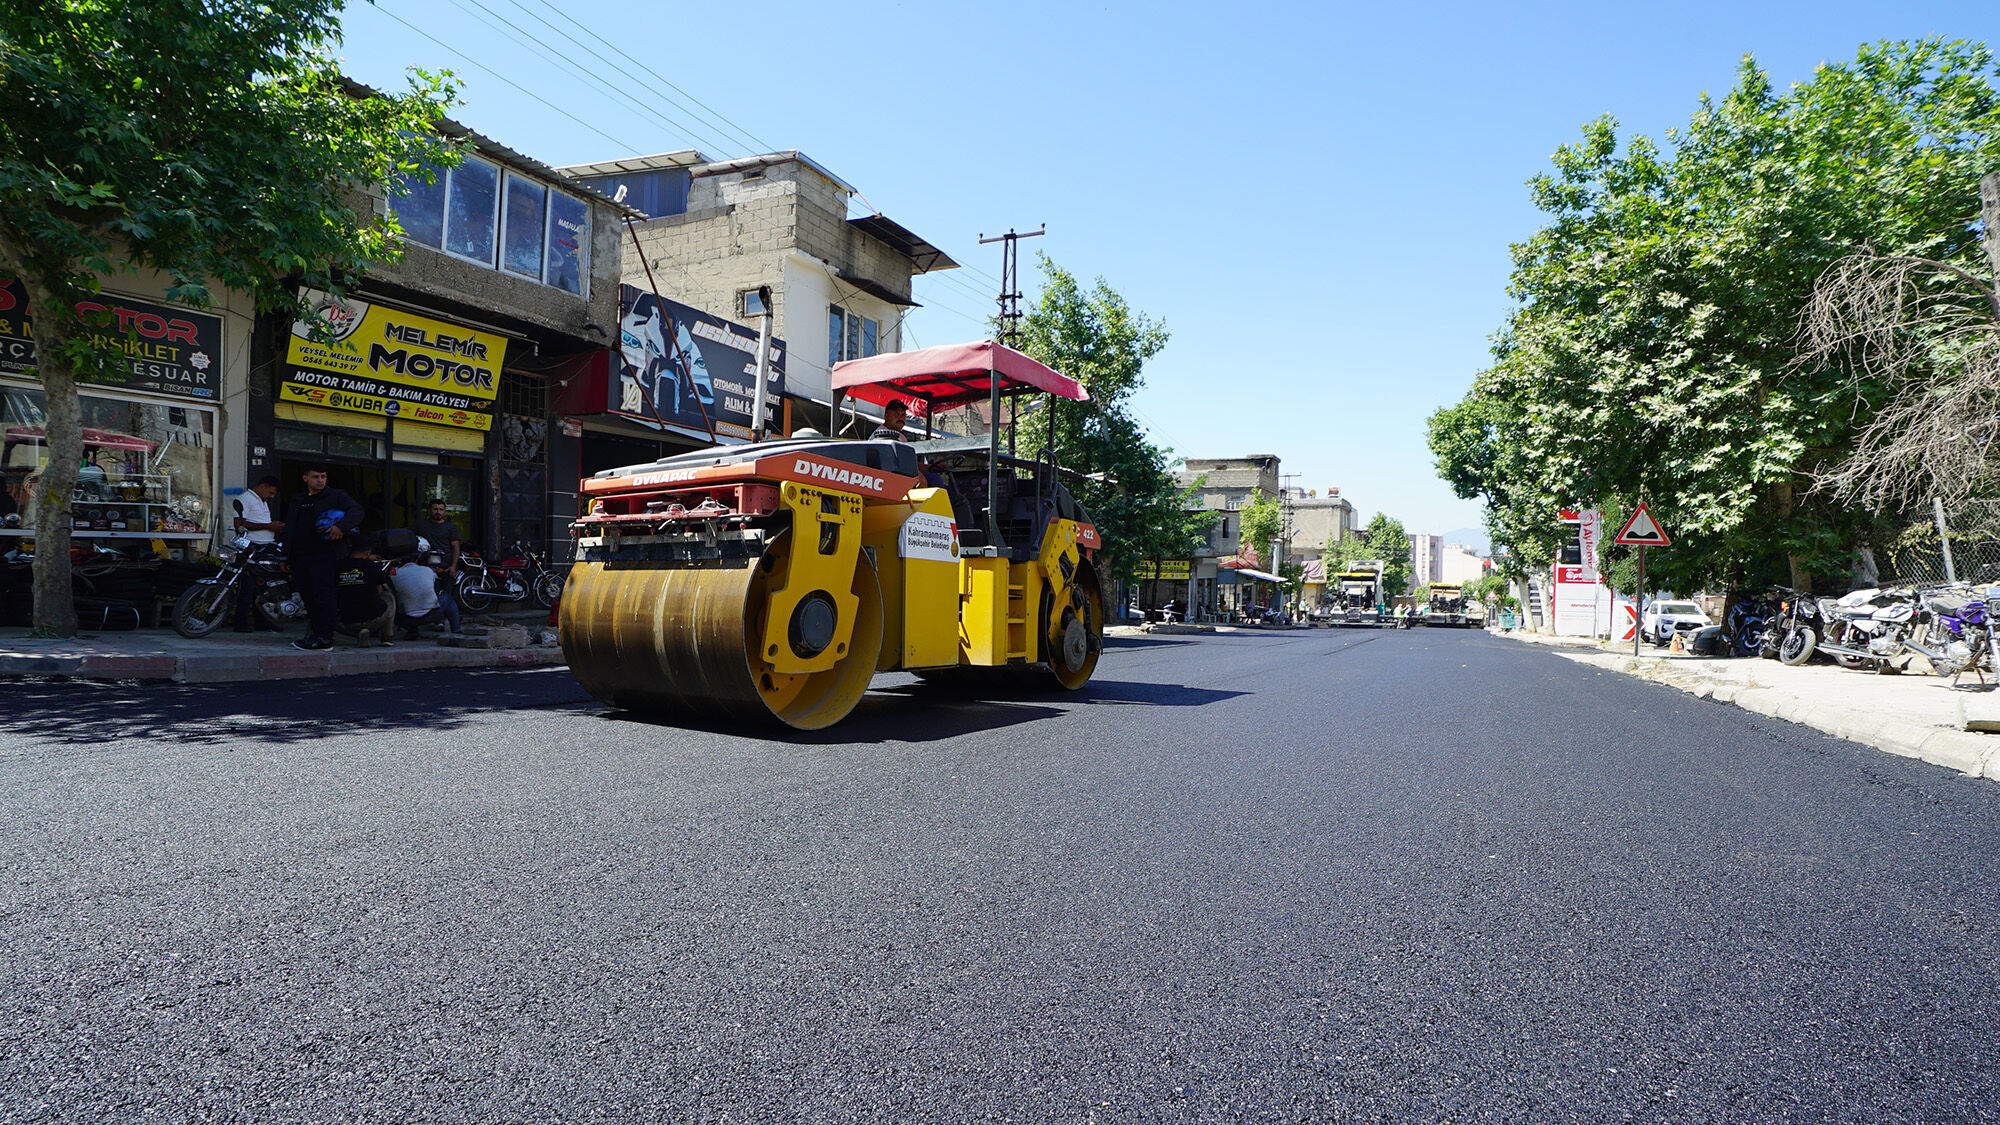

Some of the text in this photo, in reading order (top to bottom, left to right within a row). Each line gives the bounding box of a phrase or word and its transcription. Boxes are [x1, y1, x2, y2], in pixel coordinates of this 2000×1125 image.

[384, 321, 489, 361] MELEMİR
[299, 345, 364, 364] VEYSEL MELEMİR
[302, 355, 323, 365] 0545
[324, 360, 338, 368] 643
[367, 342, 494, 392] MOTOR
[294, 370, 470, 409] MOTOR TAMİR & BAKIM ATÖLYESİ
[343, 395, 383, 412] KUBA
[725, 396, 744, 412] ALIM
[745, 401, 751, 414] &
[414, 407, 444, 421] falcon
[632, 470, 698, 487] DYNAPAC
[794, 459, 885, 492] DYNAPAC
[907, 526, 950, 542] Kahramanmaraş
[907, 537, 931, 548] Büyükşehir
[1083, 528, 1094, 540] 422
